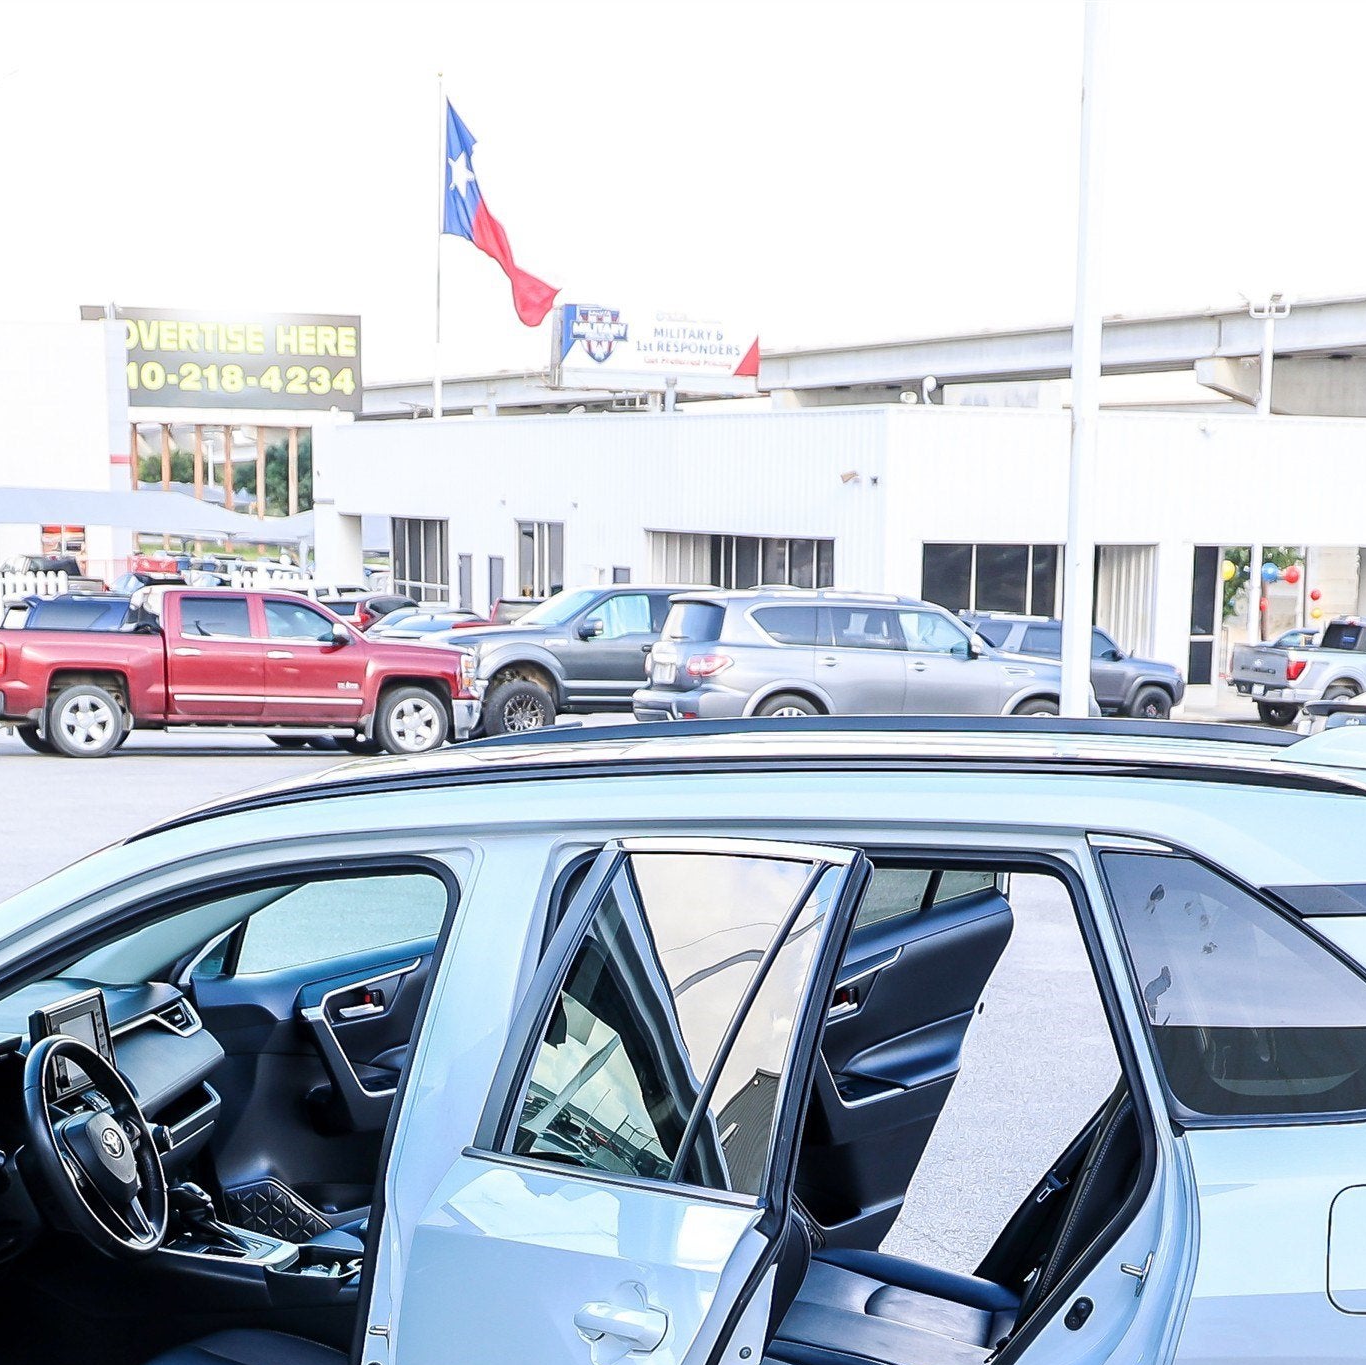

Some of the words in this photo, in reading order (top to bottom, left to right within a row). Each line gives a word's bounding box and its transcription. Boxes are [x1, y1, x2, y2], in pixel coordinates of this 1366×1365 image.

[126, 318, 265, 354] DVERTISE
[275, 324, 357, 357] HERE
[653, 327, 712, 340] MILITARY
[656, 341, 741, 356] RESPONDERS
[126, 360, 356, 396] 10-218-4234
